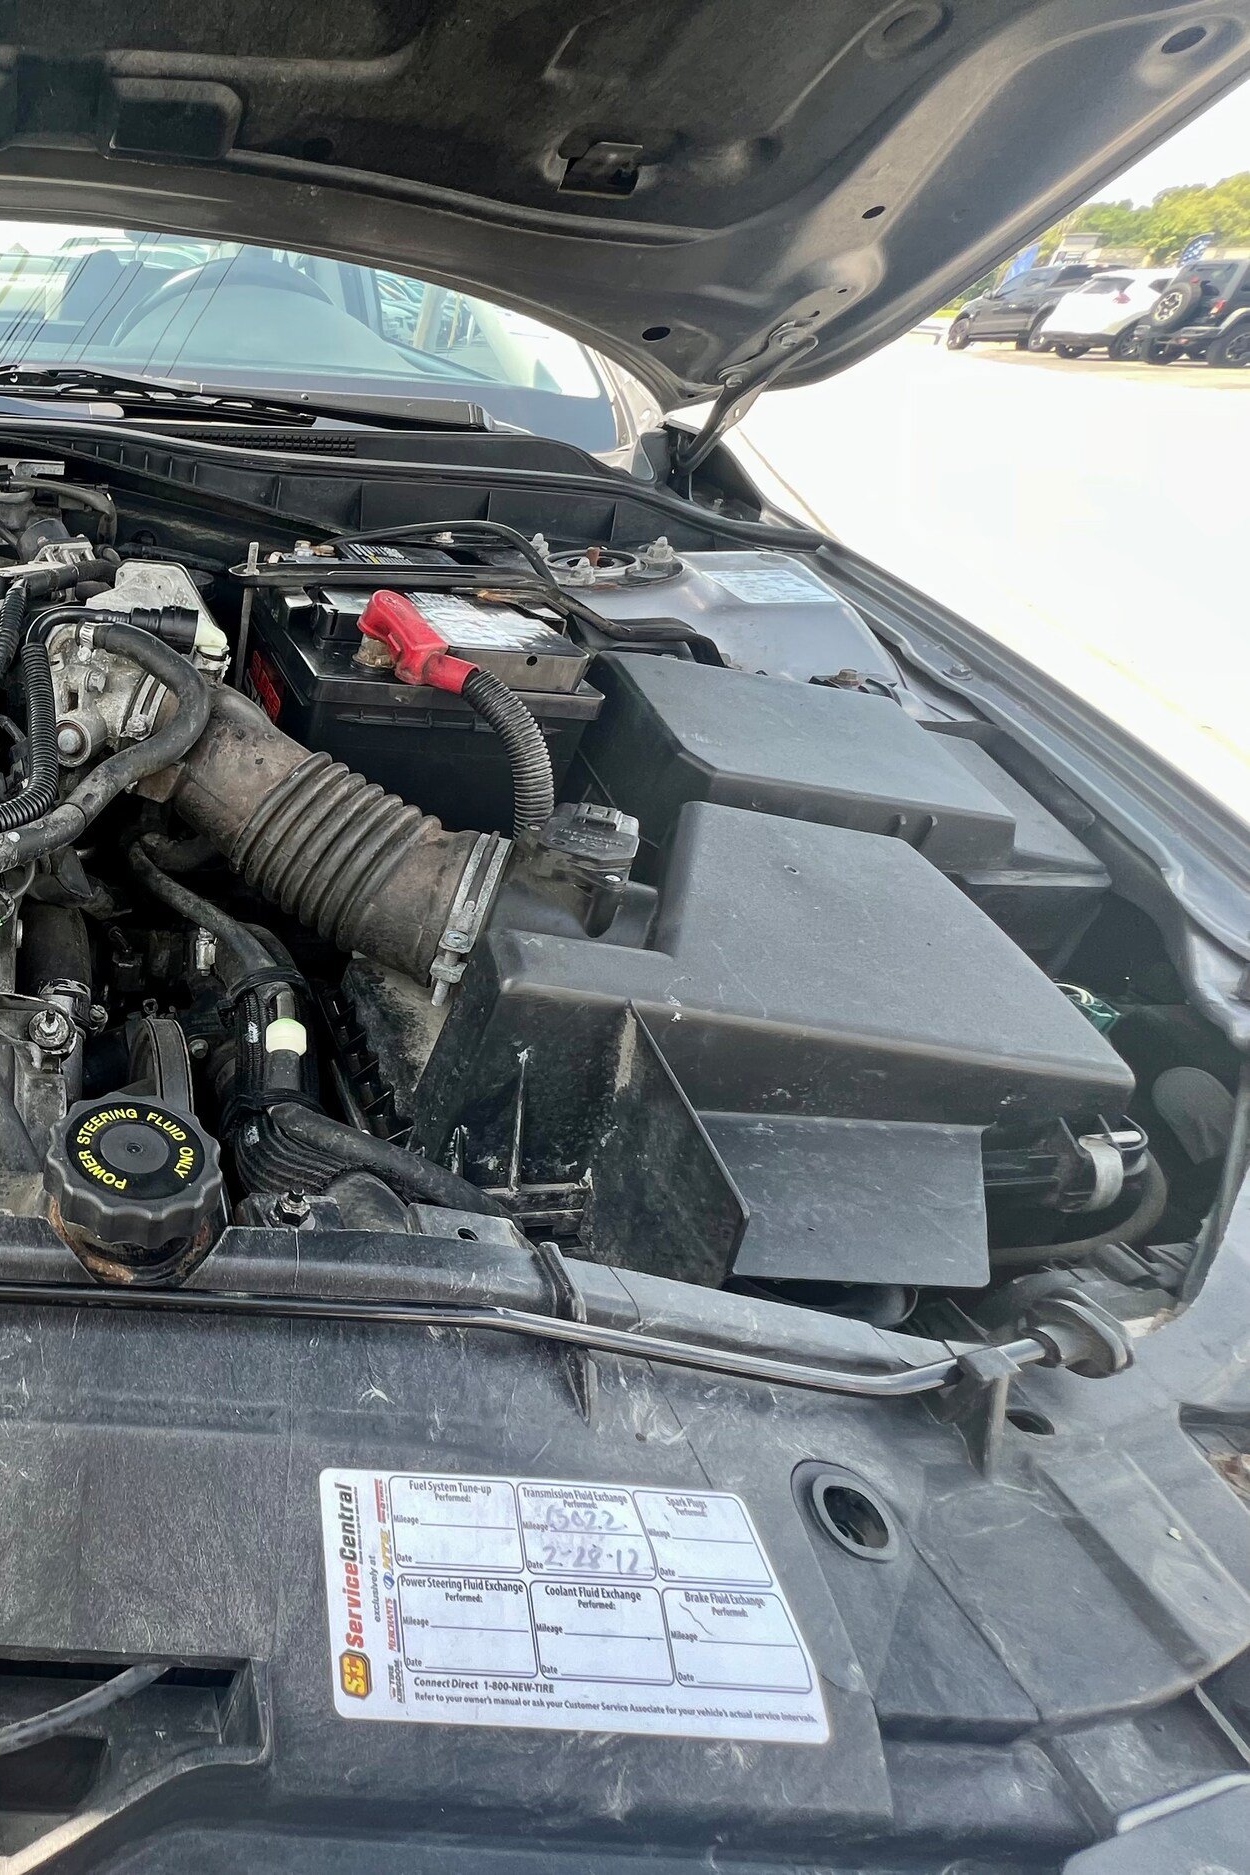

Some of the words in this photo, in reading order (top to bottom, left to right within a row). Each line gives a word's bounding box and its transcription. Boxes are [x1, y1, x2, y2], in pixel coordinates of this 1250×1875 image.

[76, 1108, 138, 1145] STEERING
[146, 1112, 187, 1141] FLUID
[173, 1146, 194, 1179] ONLY
[77, 1149, 127, 1190] POWER
[409, 1479, 427, 1491] Fuel
[429, 1480, 458, 1494] System
[458, 1482, 492, 1496] Tune-up
[434, 1492, 472, 1503] Performed:
[522, 1487, 574, 1500] Transmission
[574, 1489, 593, 1501] Fluid
[593, 1491, 628, 1506] Exchange
[665, 1495, 687, 1508] Spark
[687, 1497, 708, 1512] Plugs
[393, 1514, 419, 1526] Mileage
[521, 1521, 549, 1532] Mileage
[646, 1528, 671, 1539] Mileage
[368, 1555, 377, 1566] at
[397, 1553, 413, 1563] Date
[526, 1559, 544, 1570] Date
[334, 1482, 365, 1649] ServiceCentral
[659, 1567, 676, 1577] Date
[401, 1575, 427, 1588] Power
[428, 1577, 462, 1591] Steering
[463, 1579, 484, 1591] Fluid
[485, 1580, 524, 1594] Exchange
[370, 1567, 381, 1622] exclusively
[444, 1592, 483, 1603] Performed:
[544, 1585, 578, 1598] Coolant
[578, 1586, 600, 1599] Fluid
[600, 1587, 642, 1603] Exchange
[684, 1591, 709, 1604] Brake
[709, 1592, 730, 1605] Fluid
[730, 1594, 766, 1609] Exchange
[577, 1599, 617, 1611] Performed:
[402, 1616, 429, 1628] Mileage
[535, 1623, 563, 1636] Mileage
[670, 1630, 698, 1643] Mileage
[406, 1657, 423, 1667] Date
[541, 1664, 558, 1674] Date
[677, 1672, 695, 1682] Date
[414, 1676, 450, 1689] Connect
[451, 1678, 478, 1690] Direct
[483, 1680, 555, 1694] 1-800-NEW-TIRE
[414, 1691, 435, 1702] Refer
[436, 1693, 445, 1702] to
[445, 1694, 463, 1704] your
[463, 1695, 492, 1706] owner's
[493, 1696, 522, 1707] manual
[522, 1698, 531, 1707] or
[532, 1698, 546, 1708] ask
[546, 1699, 563, 1710] your
[564, 1700, 601, 1711] Customer
[601, 1701, 629, 1712] Service
[629, 1703, 665, 1715] Associate
[665, 1704, 677, 1716] for
[678, 1706, 696, 1717] your
[696, 1706, 728, 1718] vehicle's
[729, 1708, 753, 1719] actual
[754, 1710, 781, 1721] service
